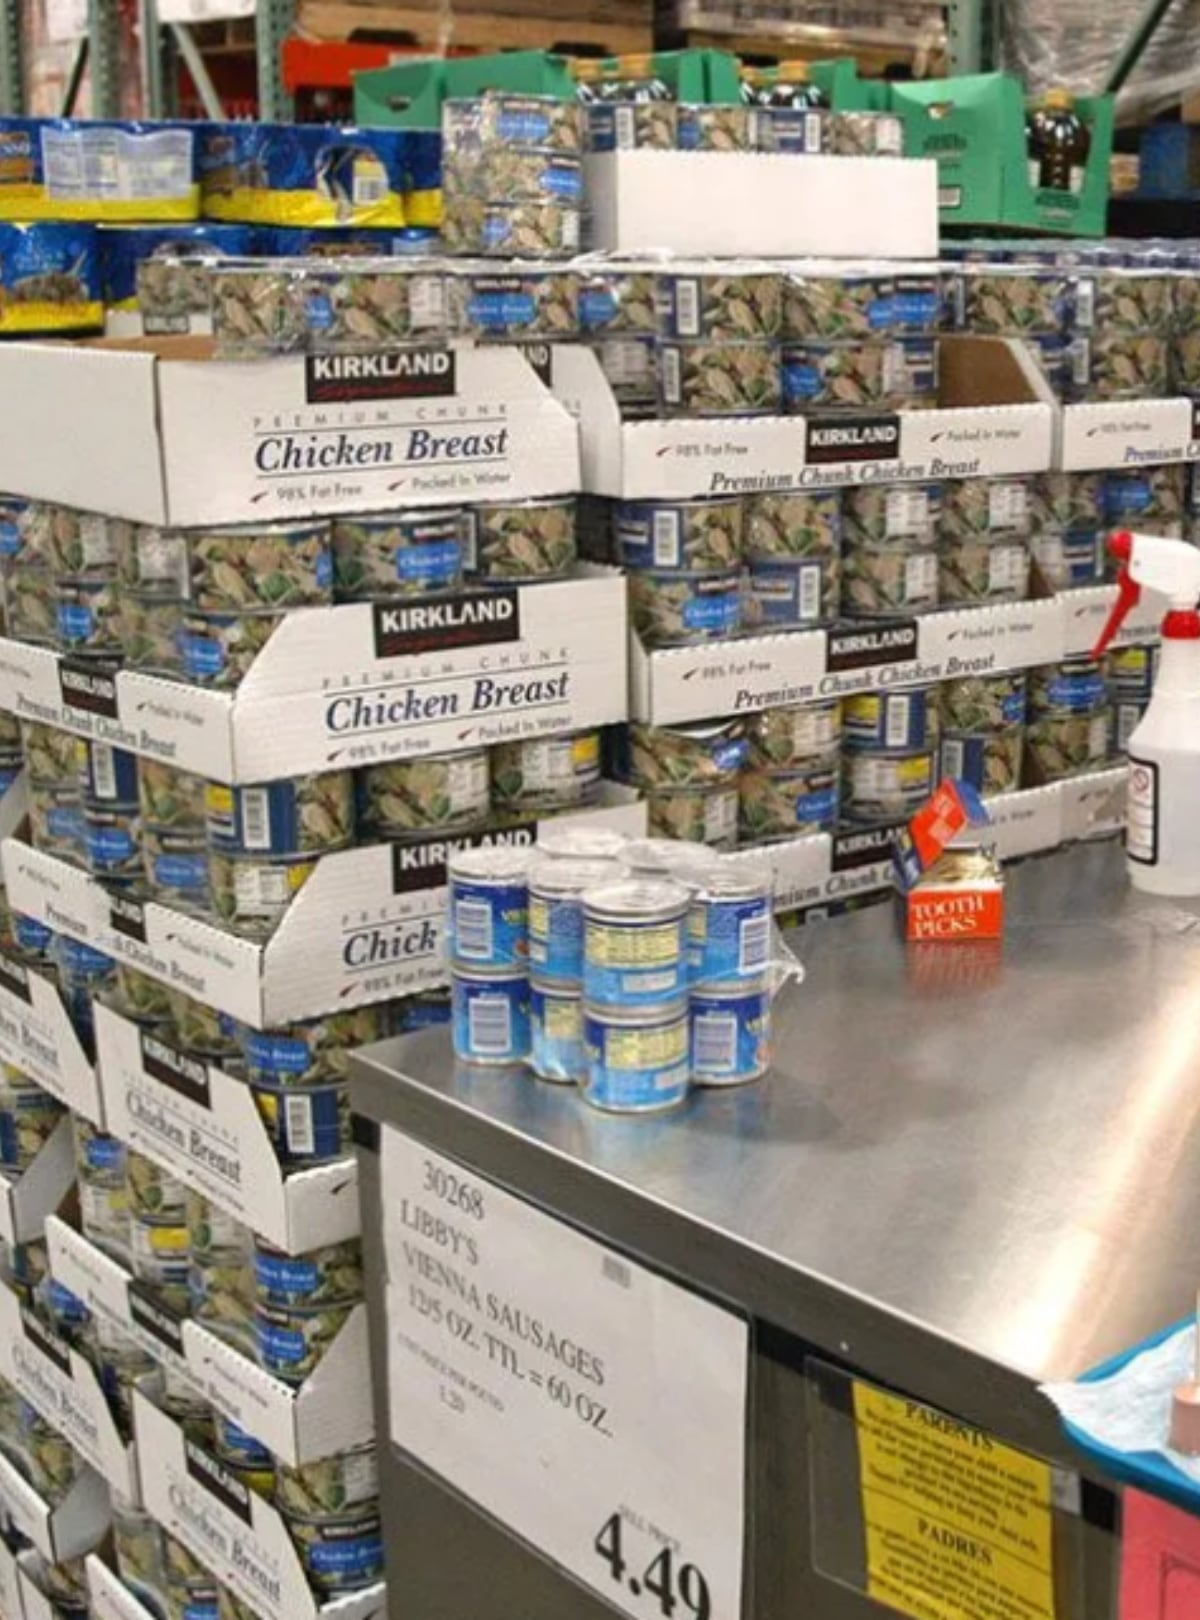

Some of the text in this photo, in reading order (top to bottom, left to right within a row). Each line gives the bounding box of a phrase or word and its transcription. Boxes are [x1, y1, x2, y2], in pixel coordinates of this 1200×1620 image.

[313, 352, 450, 380] KIRKLAND
[254, 404, 508, 429] PREMIUM CHUNK
[809, 425, 897, 446] KIRKLAND
[255, 427, 509, 472] Chicken Breast
[710, 457, 980, 491] Premium Chunk Chicken Breast
[381, 598, 514, 634] KIRKLAND
[830, 627, 915, 655] KIRKLAND
[322, 649, 569, 690] PREMIUM CHUNK
[734, 654, 995, 709] Premium Chunk Chicken Breast
[325, 672, 570, 732] Chicken Breast
[911, 894, 985, 922] TOOTH
[914, 915, 978, 939] PICKS
[343, 920, 437, 967] Chick
[190, 1127, 241, 1184] Breast
[423, 1159, 485, 1221] 30268
[401, 1199, 479, 1266] LIBBY'S
[402, 1240, 605, 1386] VIENNA SAUSAGES
[483, 1331, 525, 1380] TTL
[547, 1374, 571, 1409] 60
[904, 1402, 995, 1452] PARENTS
[917, 1517, 993, 1566] PADRES
[594, 1512, 711, 1620] 4.49
